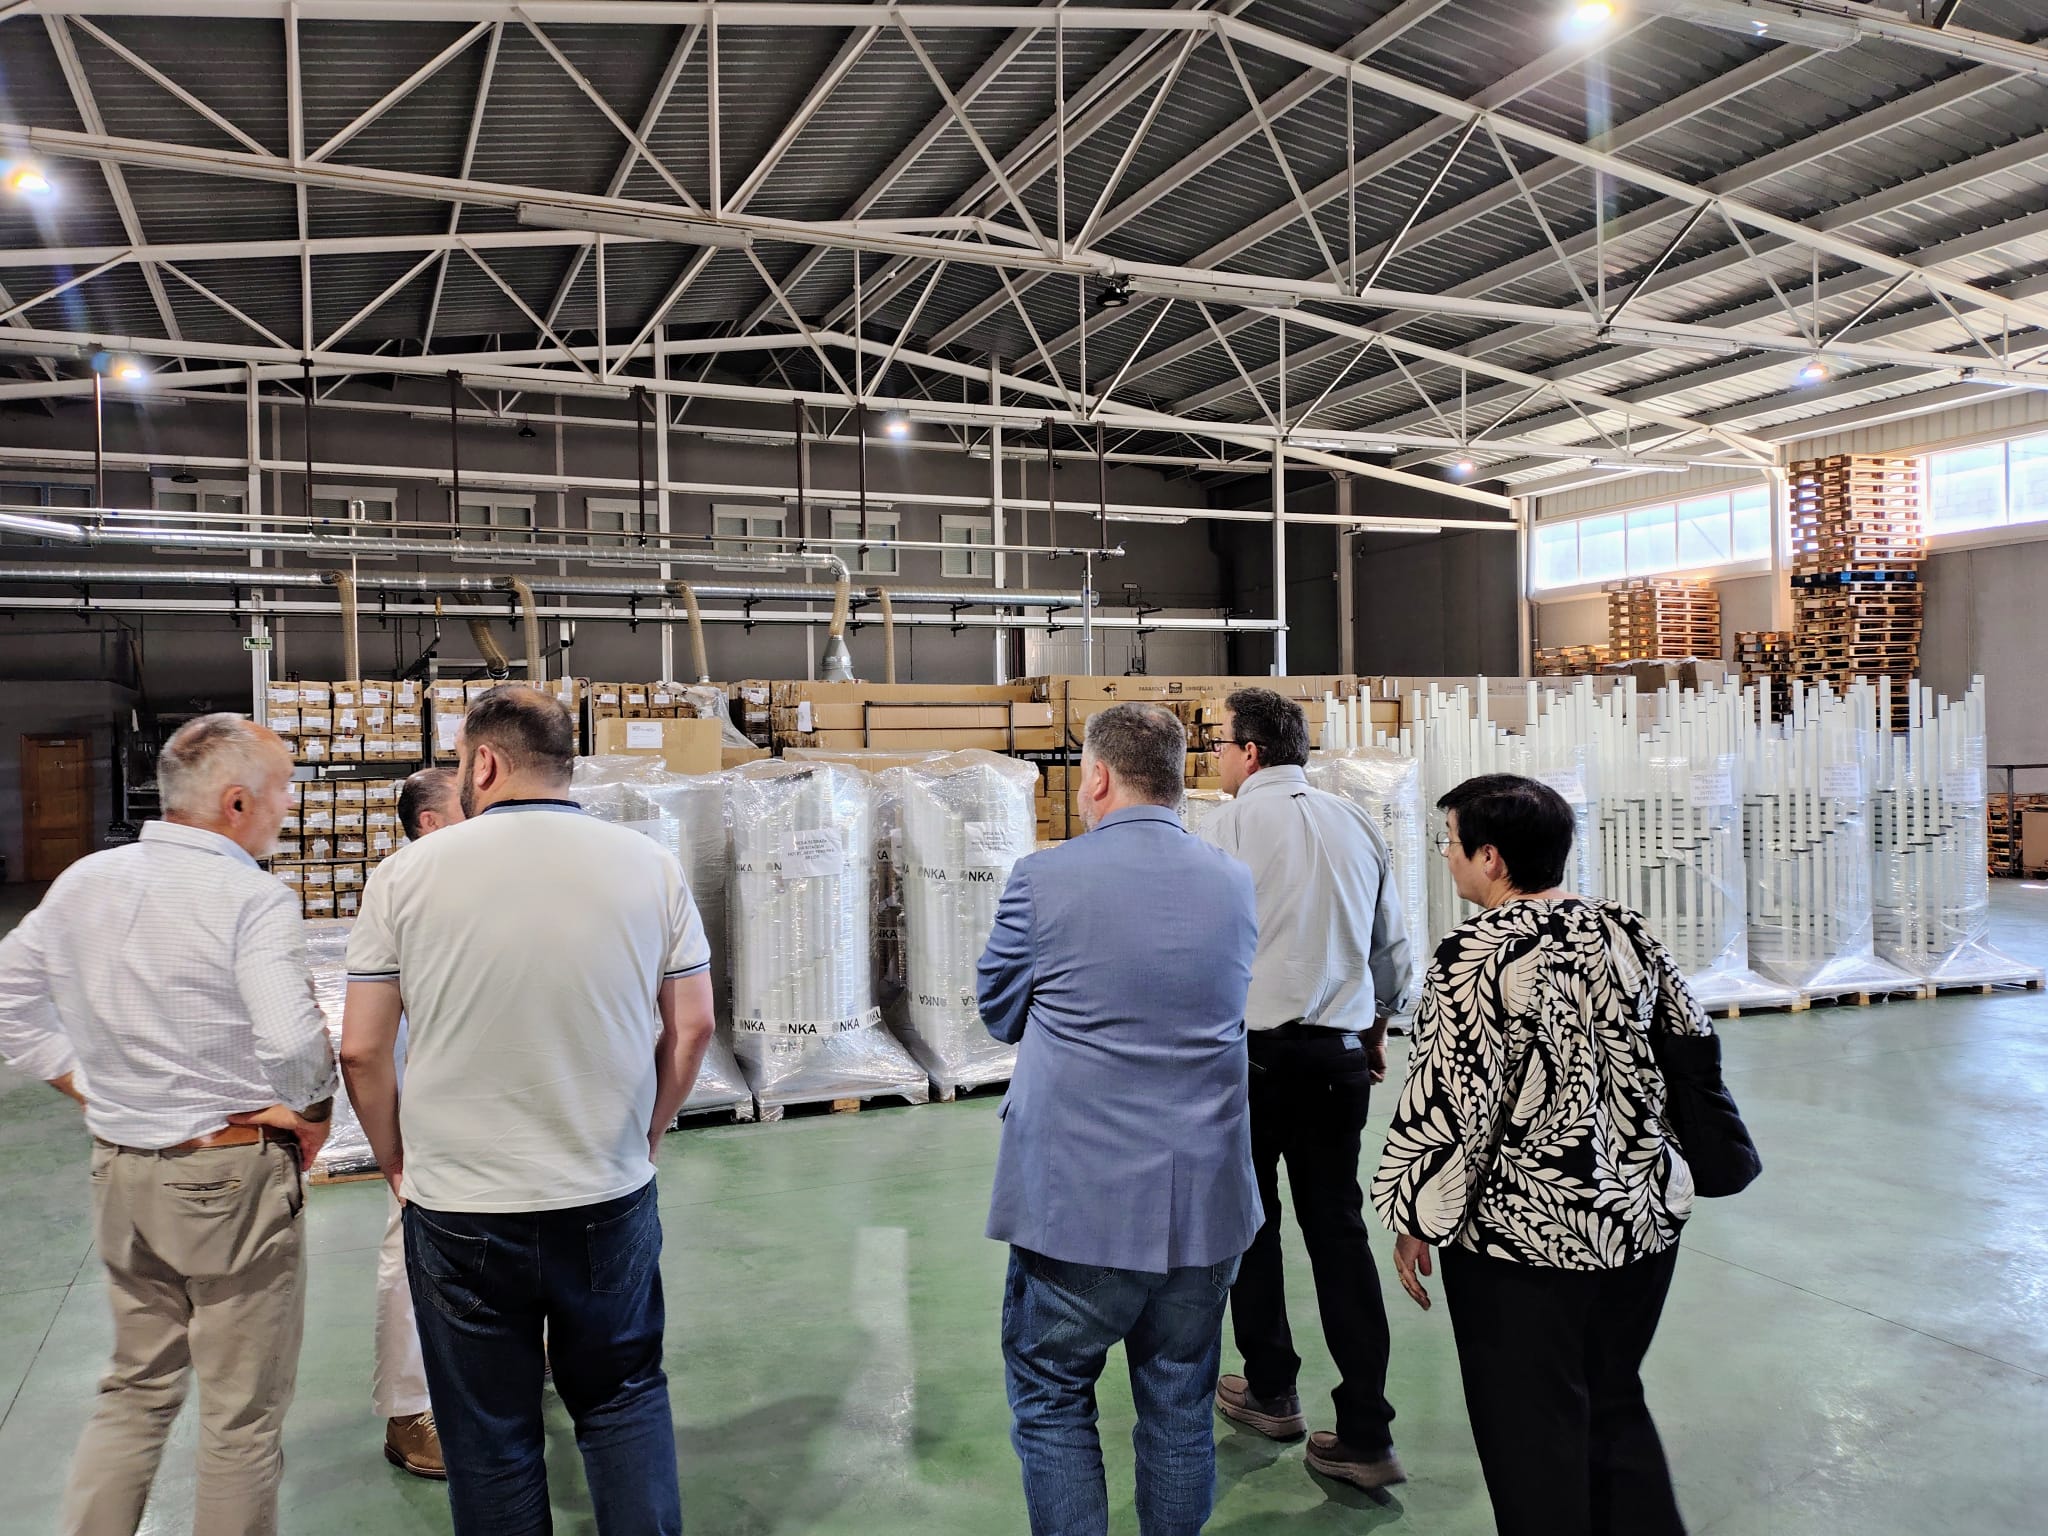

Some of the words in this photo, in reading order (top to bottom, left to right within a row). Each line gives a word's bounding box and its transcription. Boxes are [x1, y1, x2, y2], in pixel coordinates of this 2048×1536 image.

[923, 867, 947, 880] NKA
[968, 871, 995, 882] NKA
[743, 1019, 766, 1032] NKA
[788, 1023, 818, 1034] NKA
[839, 1017, 860, 1032] NKA
